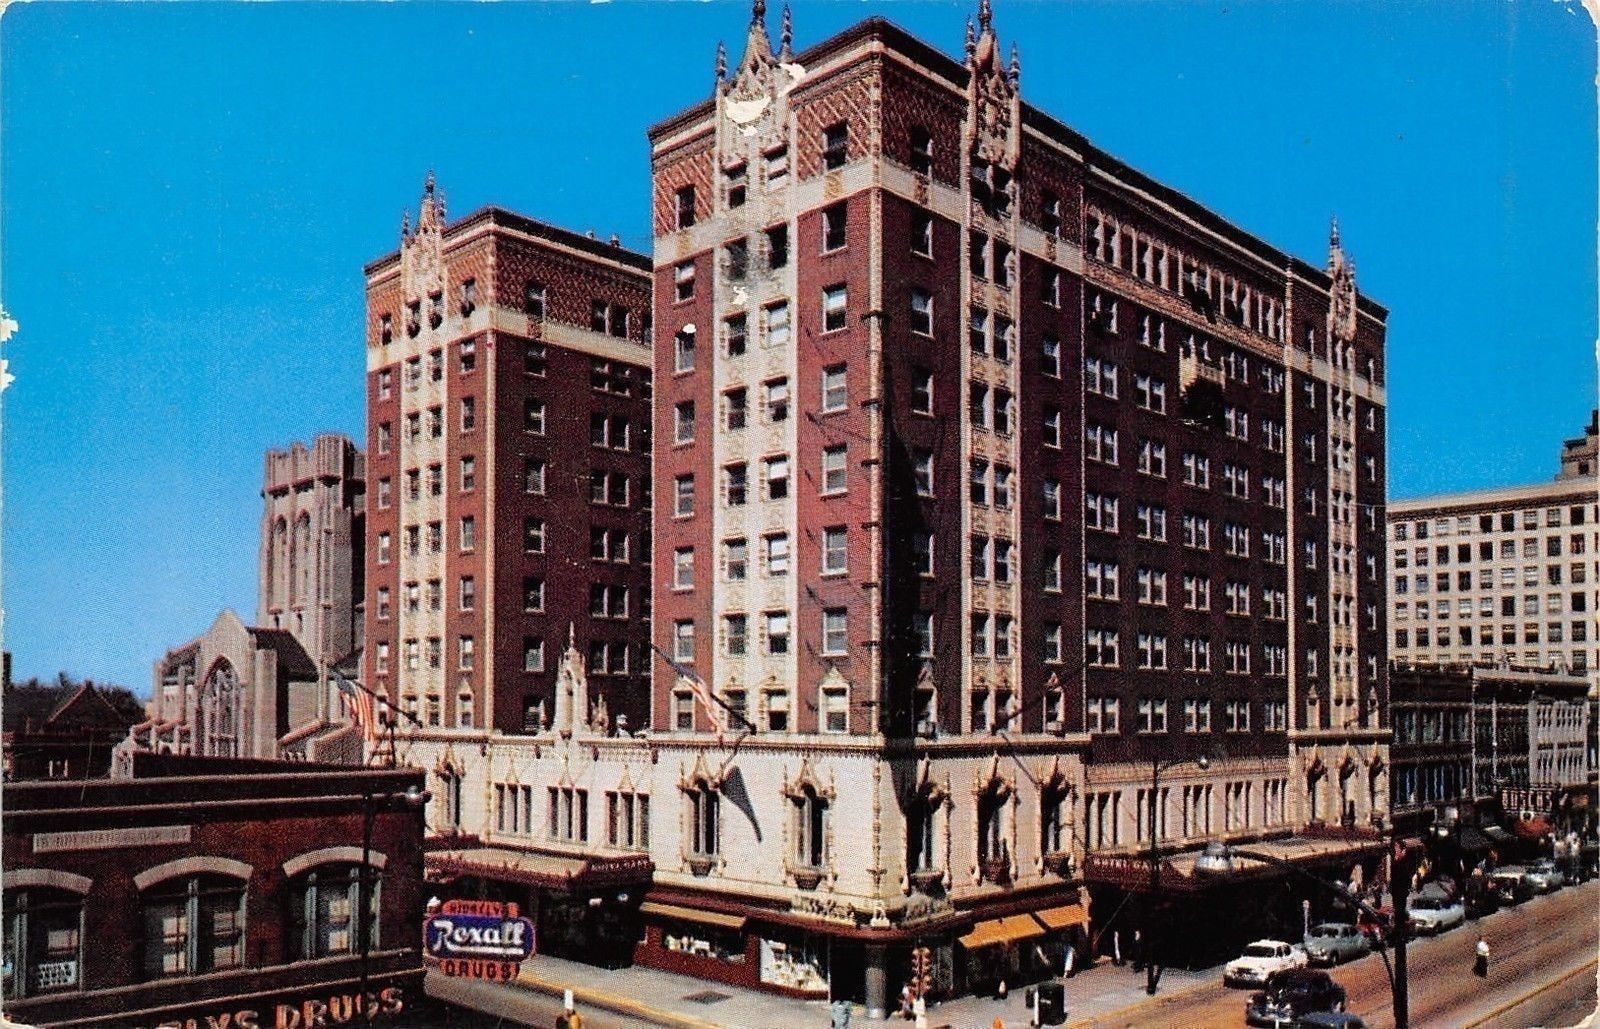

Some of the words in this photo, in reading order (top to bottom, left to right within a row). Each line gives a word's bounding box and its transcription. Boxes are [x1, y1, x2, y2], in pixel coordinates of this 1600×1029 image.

[432, 920, 525, 954] Rexall
[444, 960, 512, 980] DRUGS
[275, 987, 404, 1029] DRUGS
